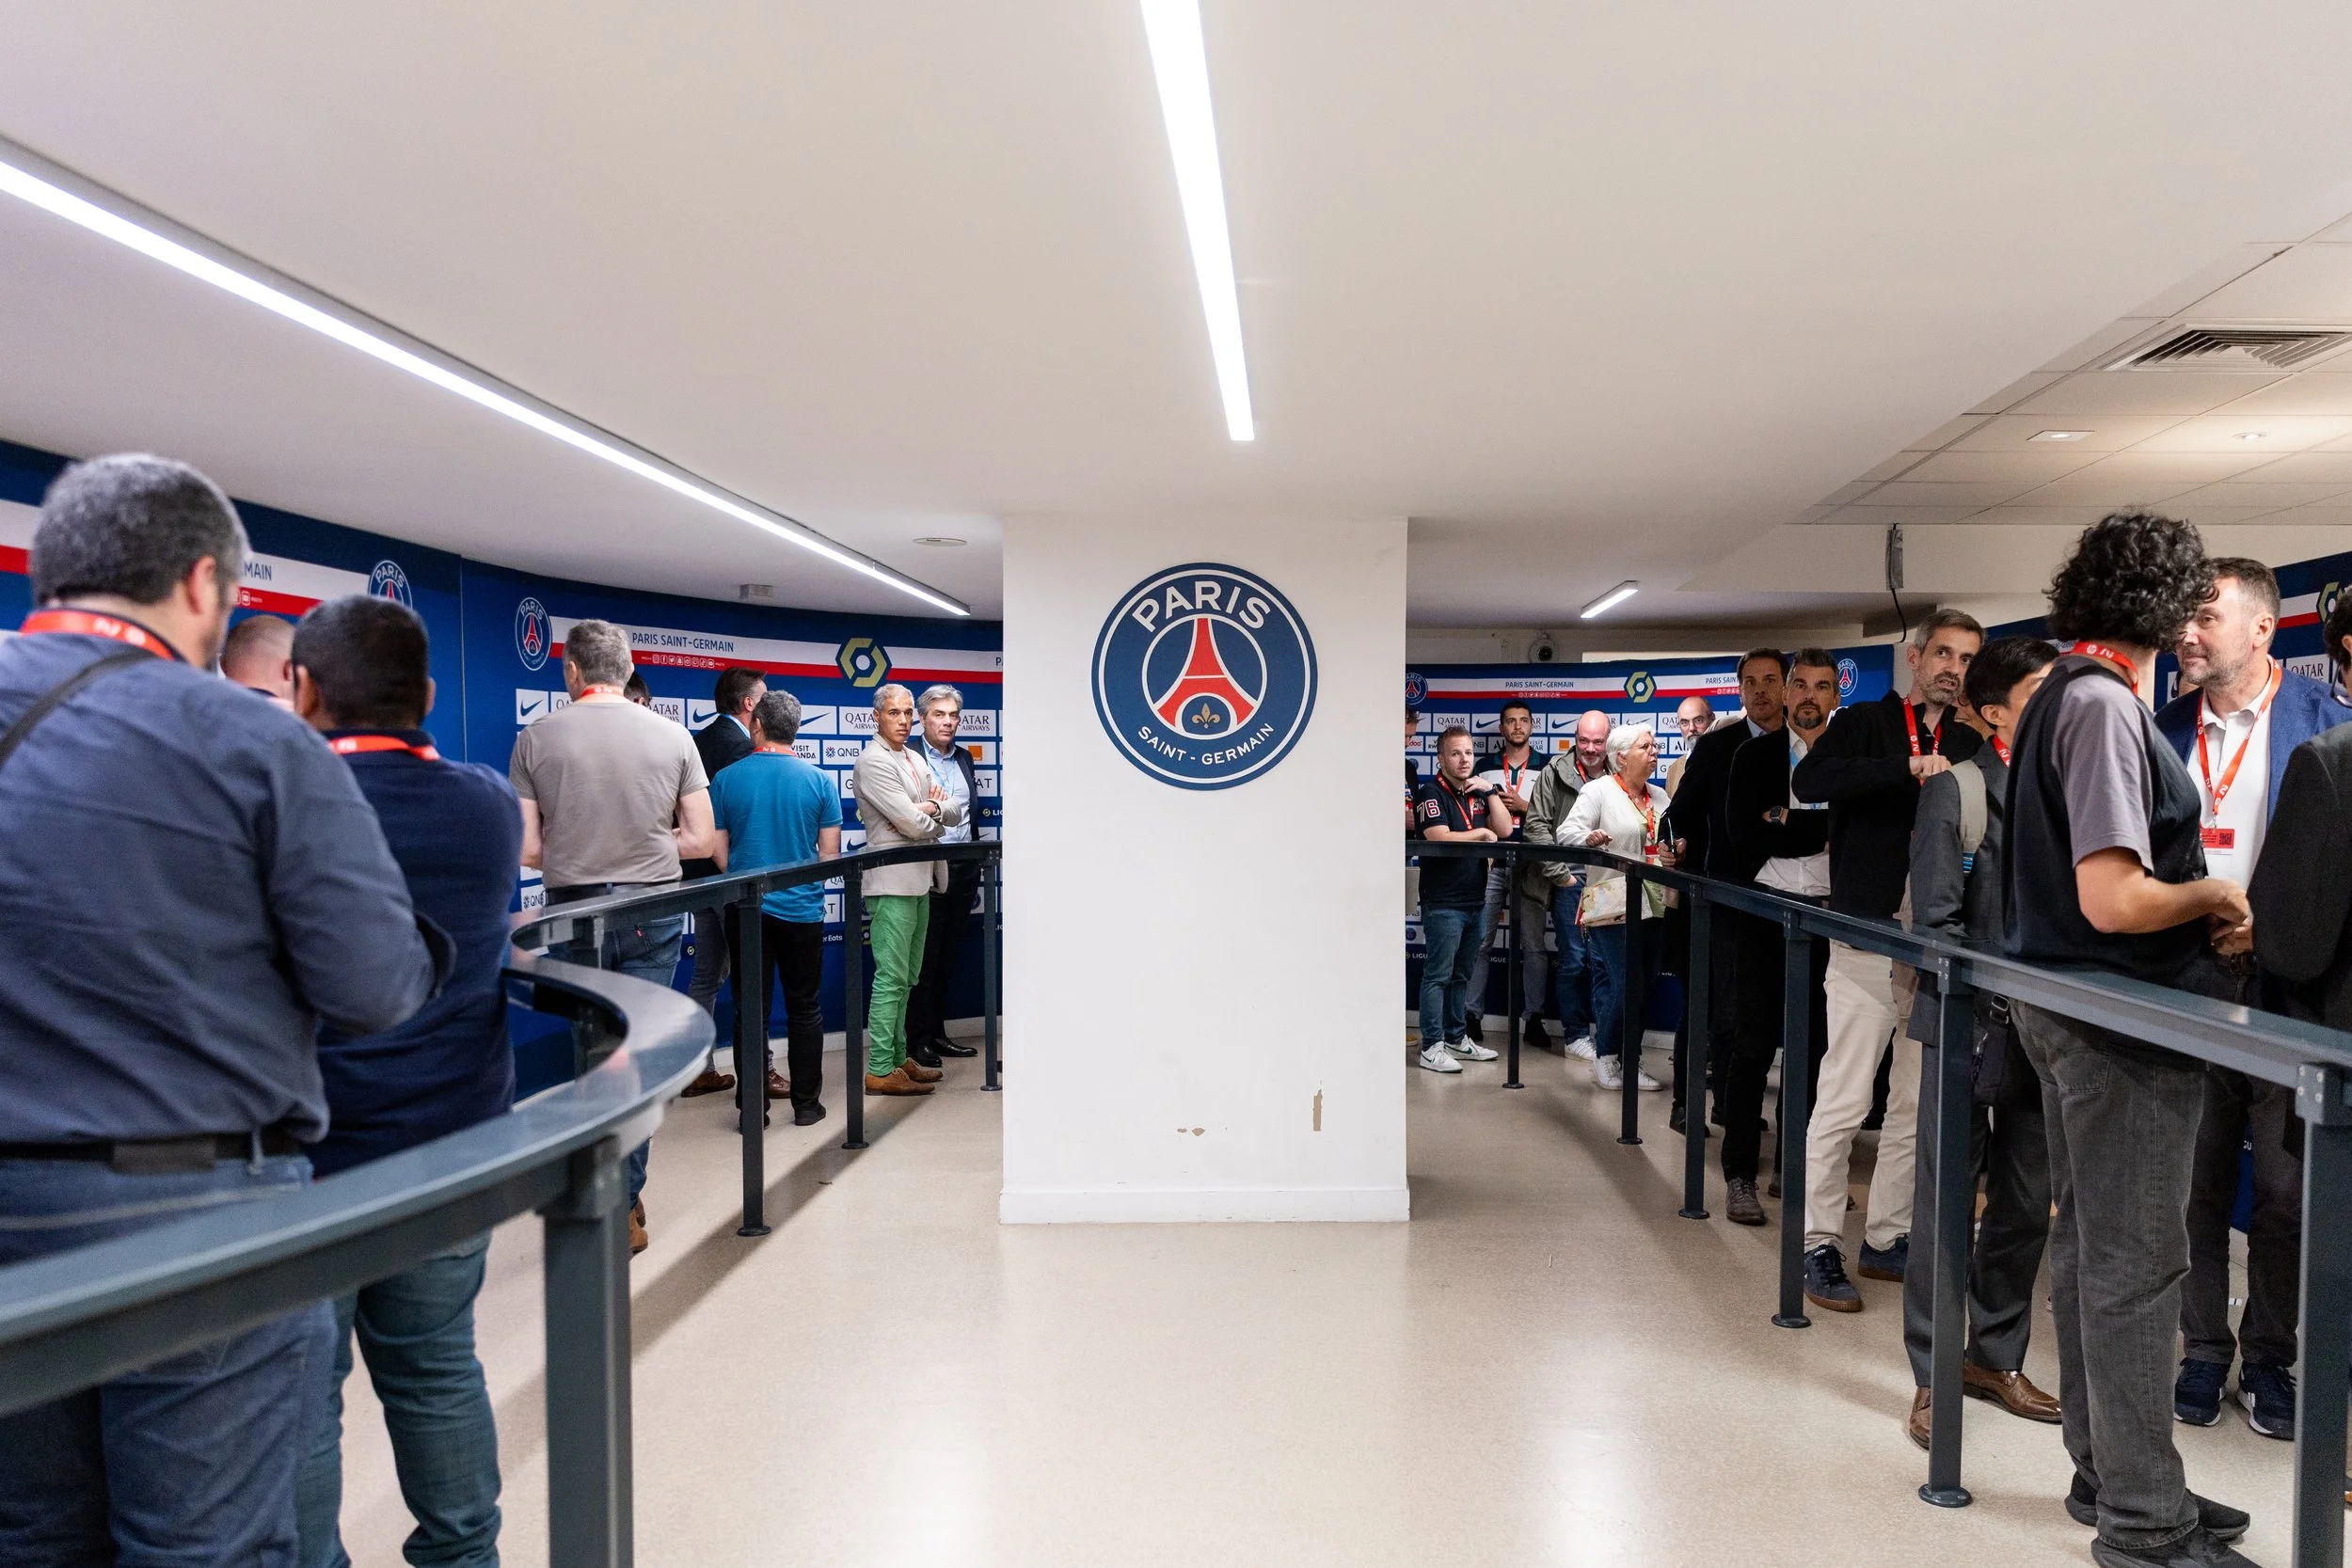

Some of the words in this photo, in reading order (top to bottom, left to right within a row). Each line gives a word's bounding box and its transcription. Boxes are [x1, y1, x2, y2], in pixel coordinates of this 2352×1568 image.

[375, 566, 405, 589] PARIS
[520, 601, 545, 620] PARIS
[1131, 580, 1271, 633] PARIS
[632, 632, 659, 645] PARIS
[660, 635, 734, 653] SAINT-GERMAIN
[1406, 673, 1422, 683] ARIS
[649, 704, 679, 716] ATAR
[845, 712, 875, 725] QATA
[1437, 717, 1466, 725] QATAR
[837, 748, 860, 758] QNB
[1137, 725, 1187, 762] SAINT
[1200, 722, 1276, 766] GERMAIN
[1417, 799, 1440, 823] 76
